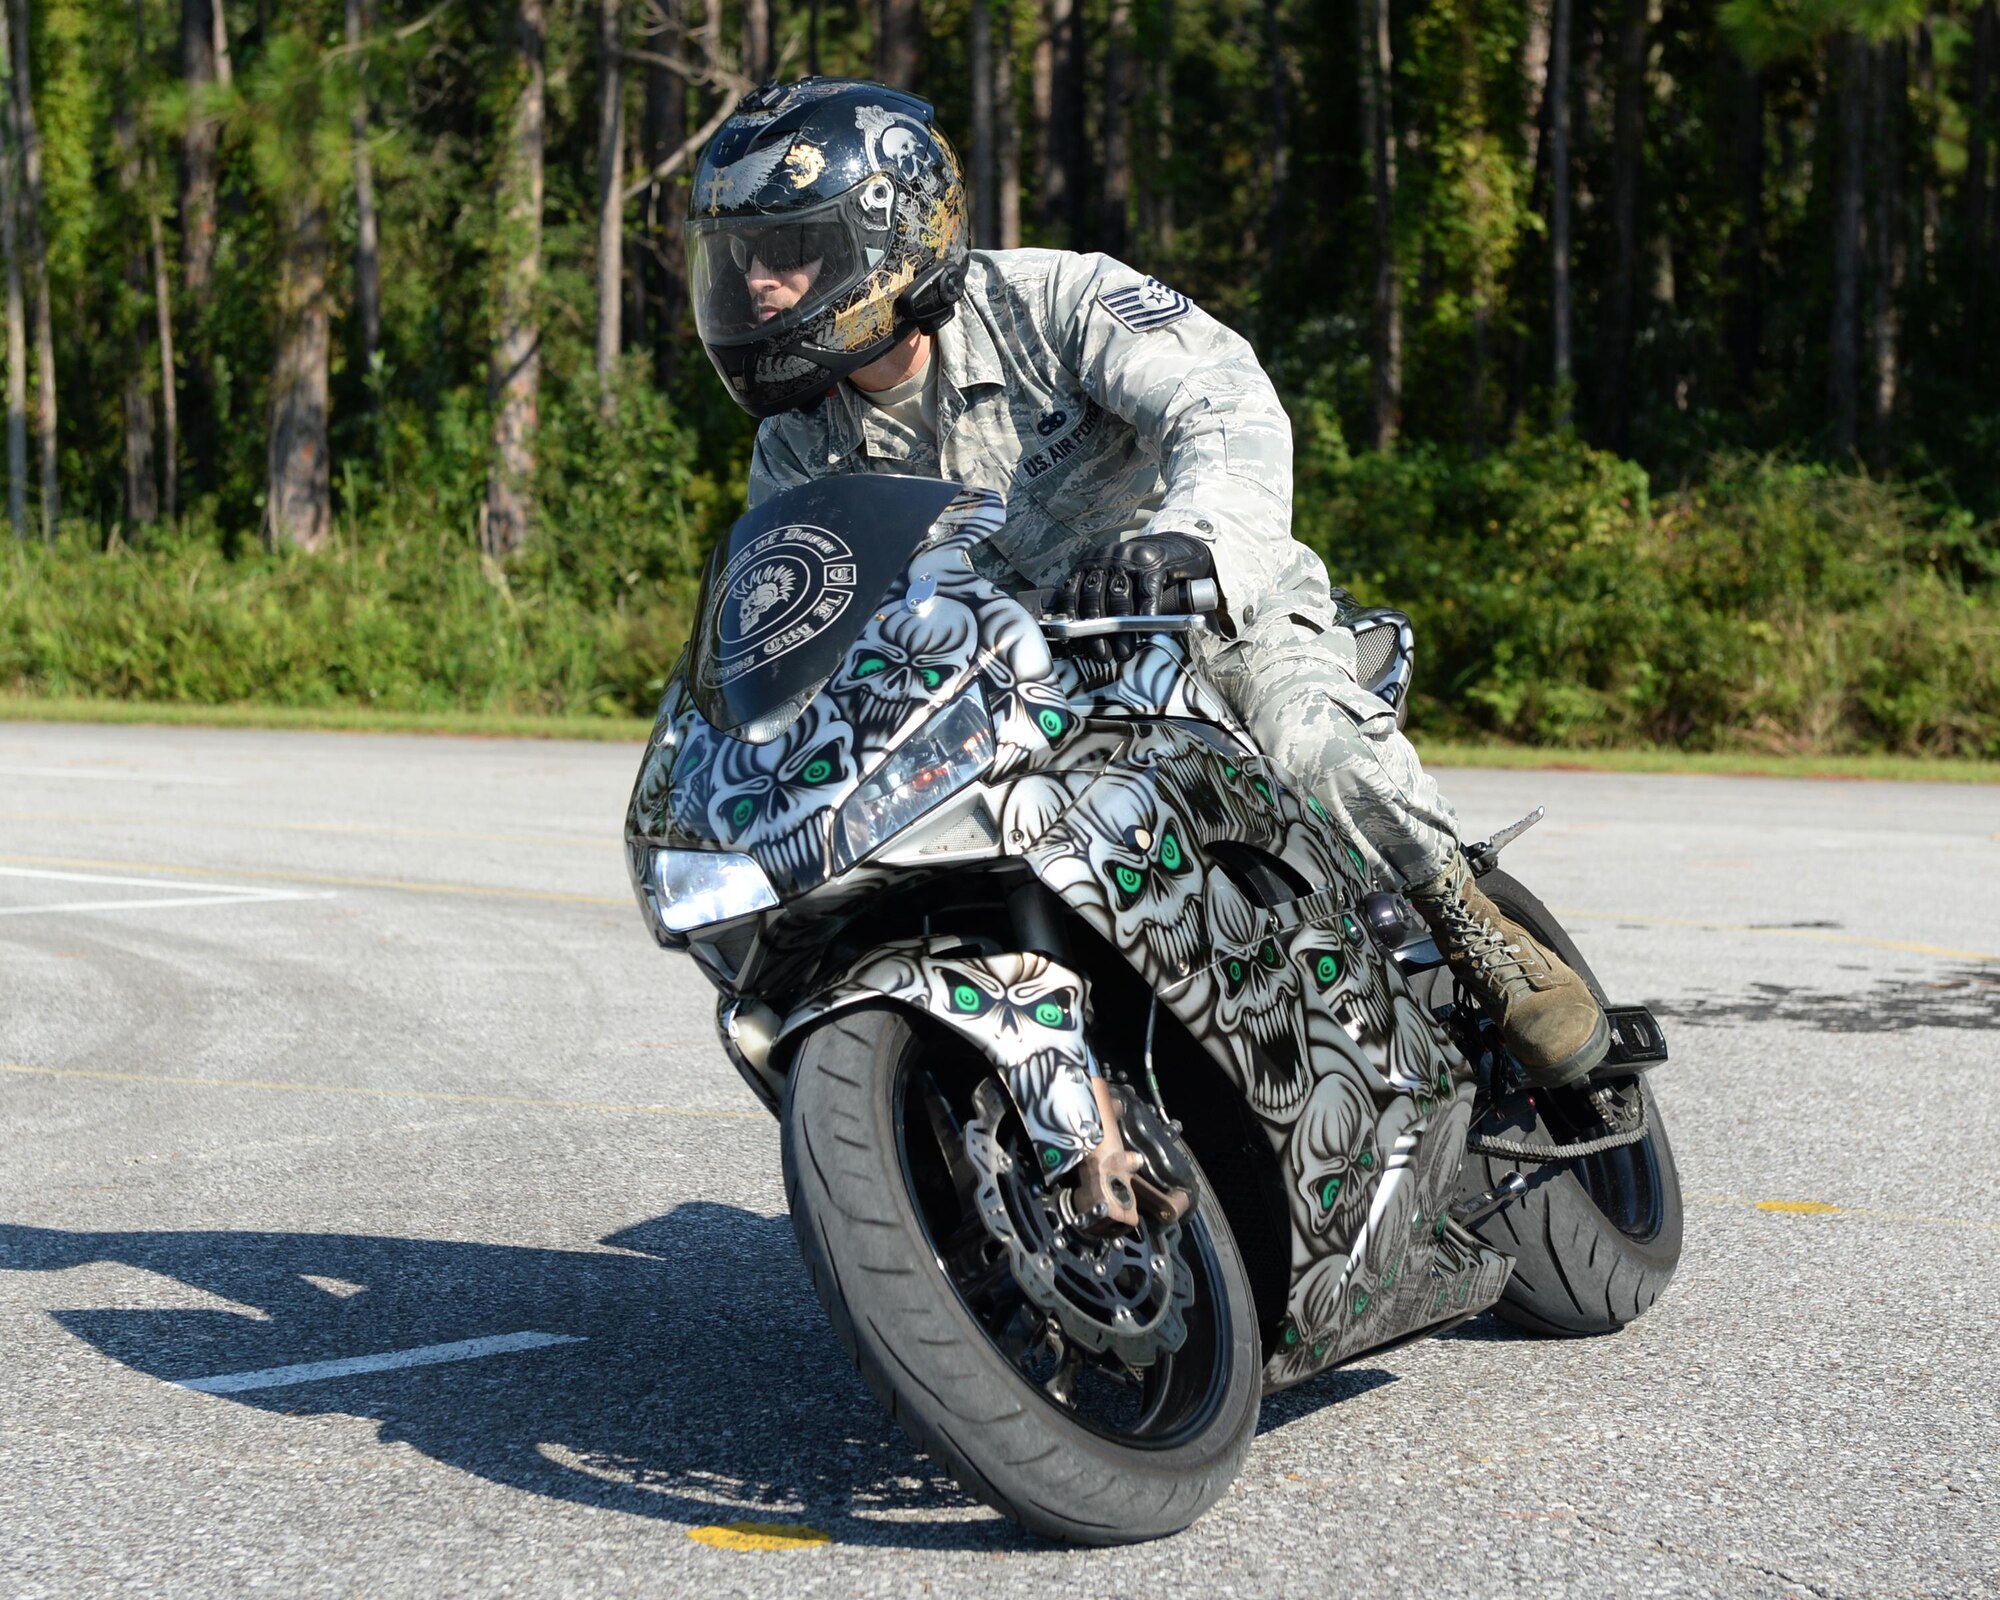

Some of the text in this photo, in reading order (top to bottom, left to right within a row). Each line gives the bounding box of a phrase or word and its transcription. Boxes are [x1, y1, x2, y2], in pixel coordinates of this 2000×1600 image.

[1023, 455, 1052, 477] U.S.
[1048, 439, 1076, 464] AIR
[782, 528, 837, 554] Doom
[763, 623, 815, 655] City
